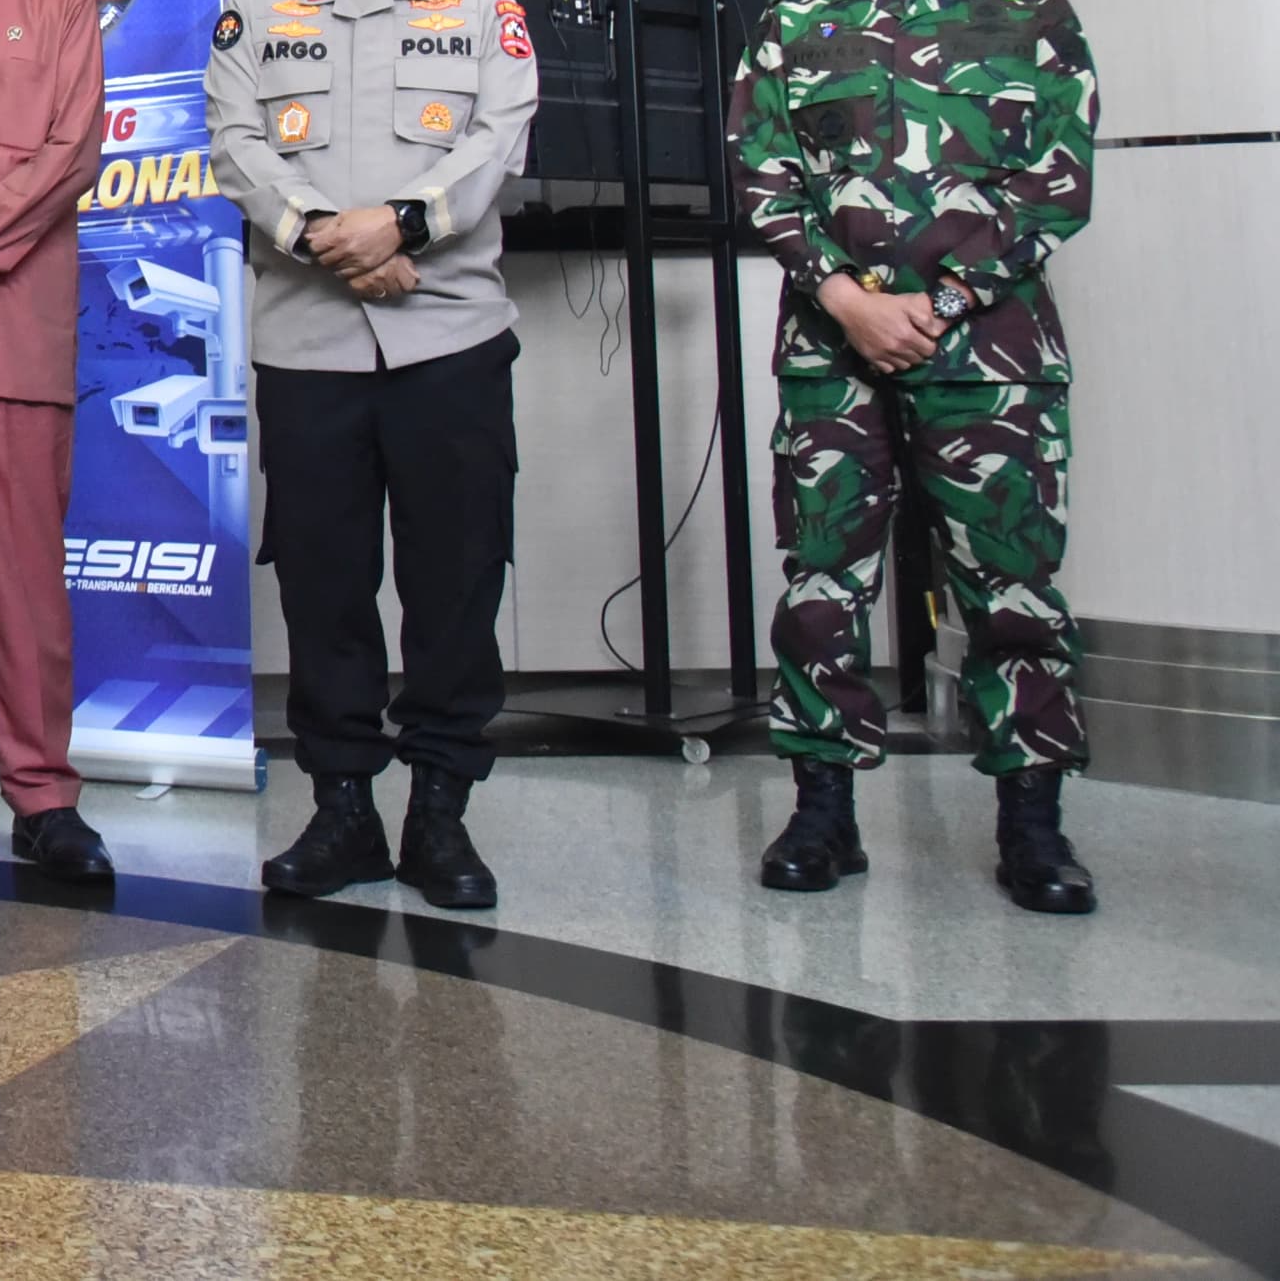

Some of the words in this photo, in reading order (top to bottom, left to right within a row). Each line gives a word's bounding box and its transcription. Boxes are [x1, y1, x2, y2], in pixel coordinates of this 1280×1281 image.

[262, 41, 328, 63] ARGO
[401, 36, 472, 57] POLRI
[146, 582, 213, 597] BERKEADILAN
